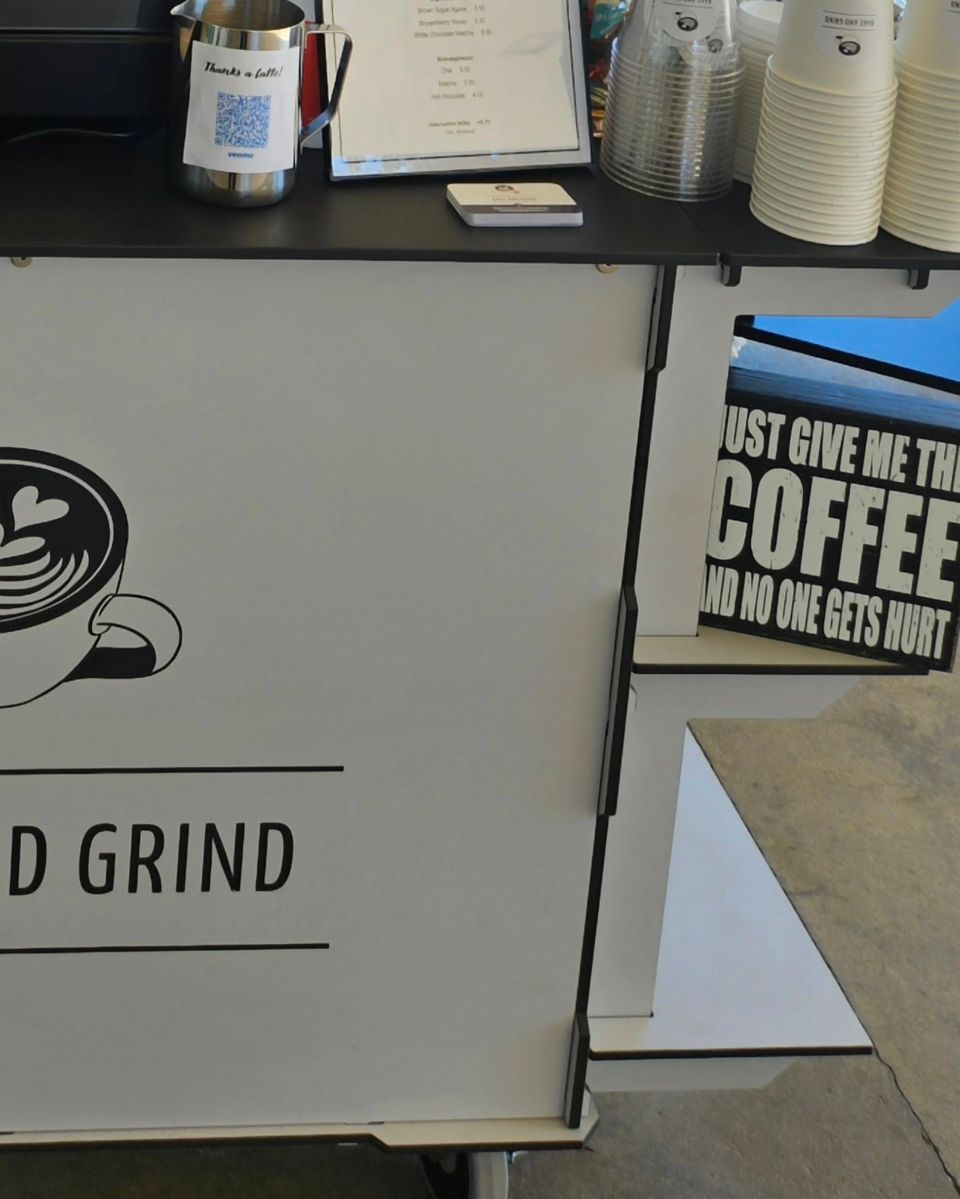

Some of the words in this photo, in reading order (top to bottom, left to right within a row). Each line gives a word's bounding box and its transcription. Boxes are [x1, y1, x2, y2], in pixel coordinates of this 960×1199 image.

[204, 61, 241, 77] Thanks
[720, 404, 786, 460] UST
[788, 416, 860, 474] GIVE
[861, 429, 910, 483] ME
[705, 458, 960, 603] COFFEE
[740, 571, 774, 626] NO
[776, 578, 823, 635] ONE
[823, 587, 883, 648] GETS
[883, 599, 952, 660] HURT
[77, 821, 295, 895] GRIND
